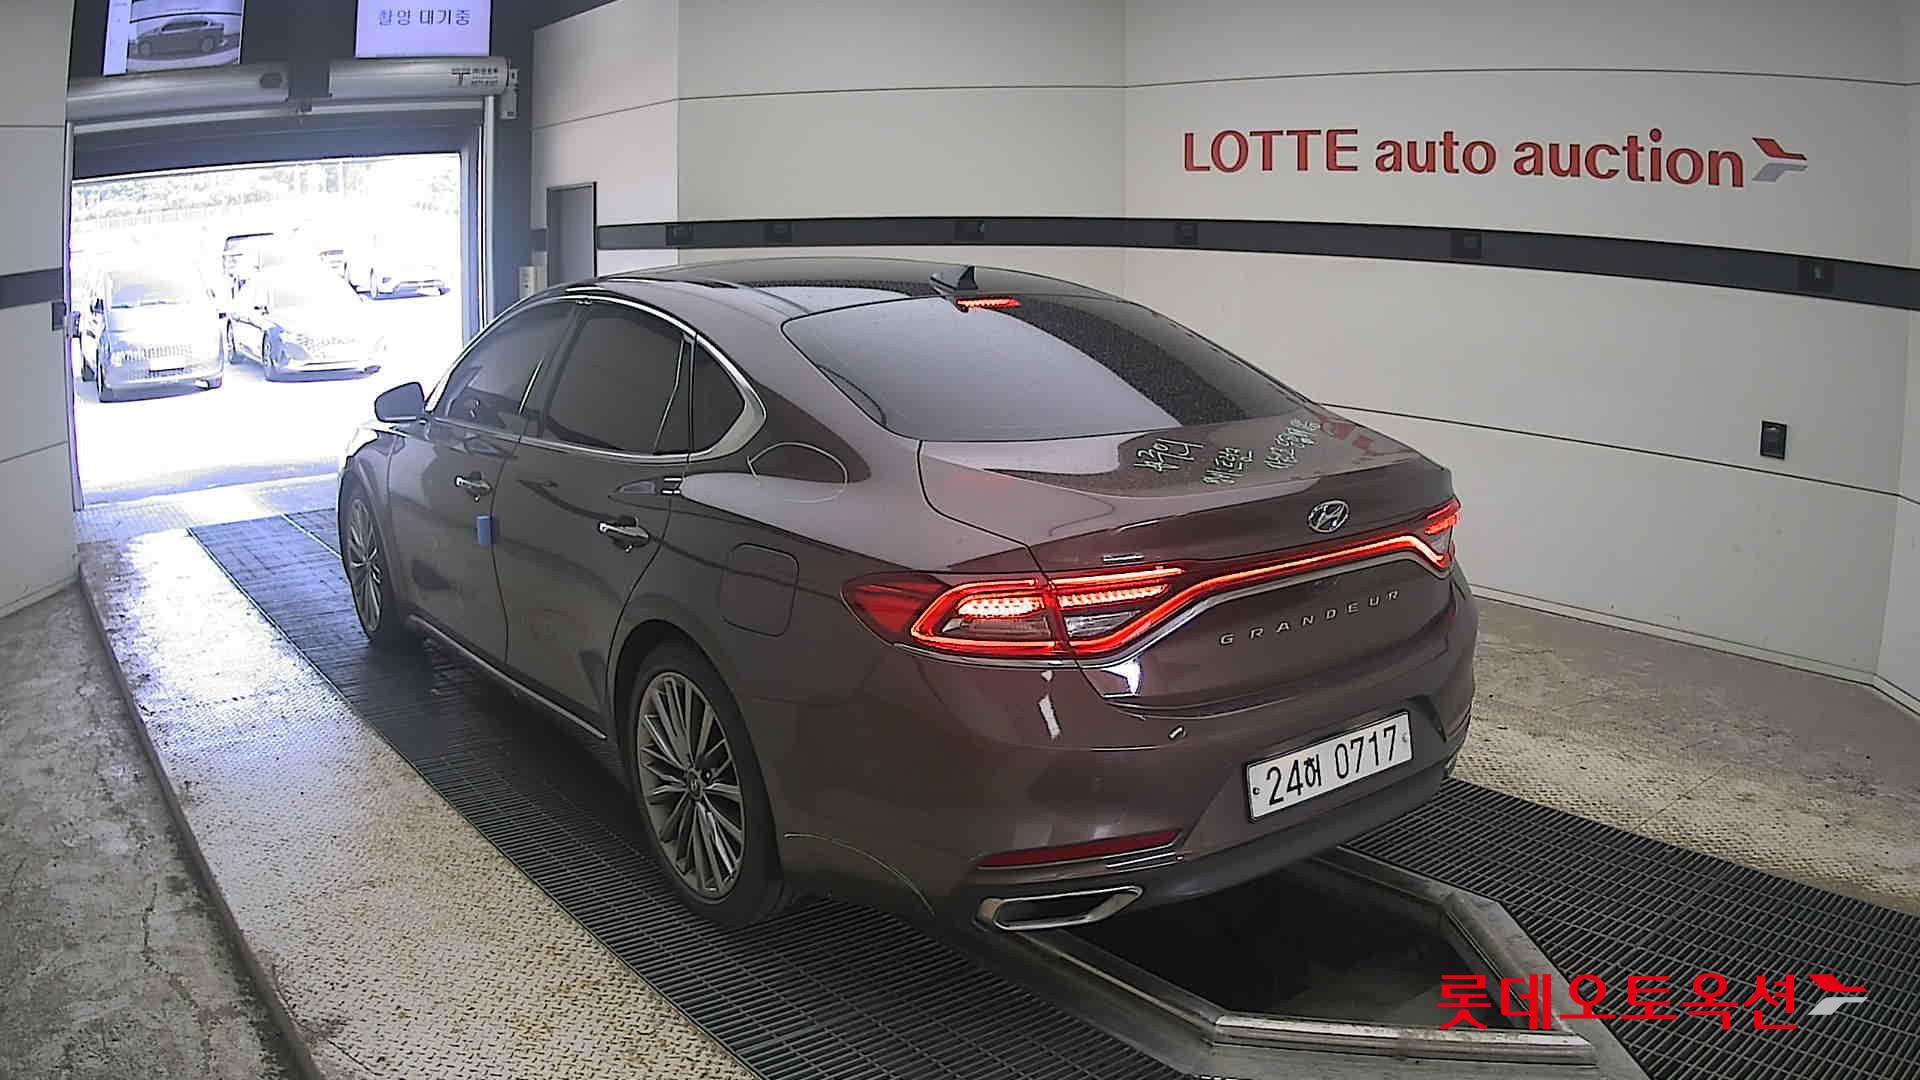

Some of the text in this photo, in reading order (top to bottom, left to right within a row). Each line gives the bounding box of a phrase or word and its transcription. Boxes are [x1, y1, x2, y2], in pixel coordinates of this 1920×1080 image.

[419, 8, 471, 26] 대기중
[1183, 127, 1745, 188] LOTTE auto auction
[1219, 590, 1400, 646] GRANDEUR
[1265, 724, 1398, 806] 24허 0717
